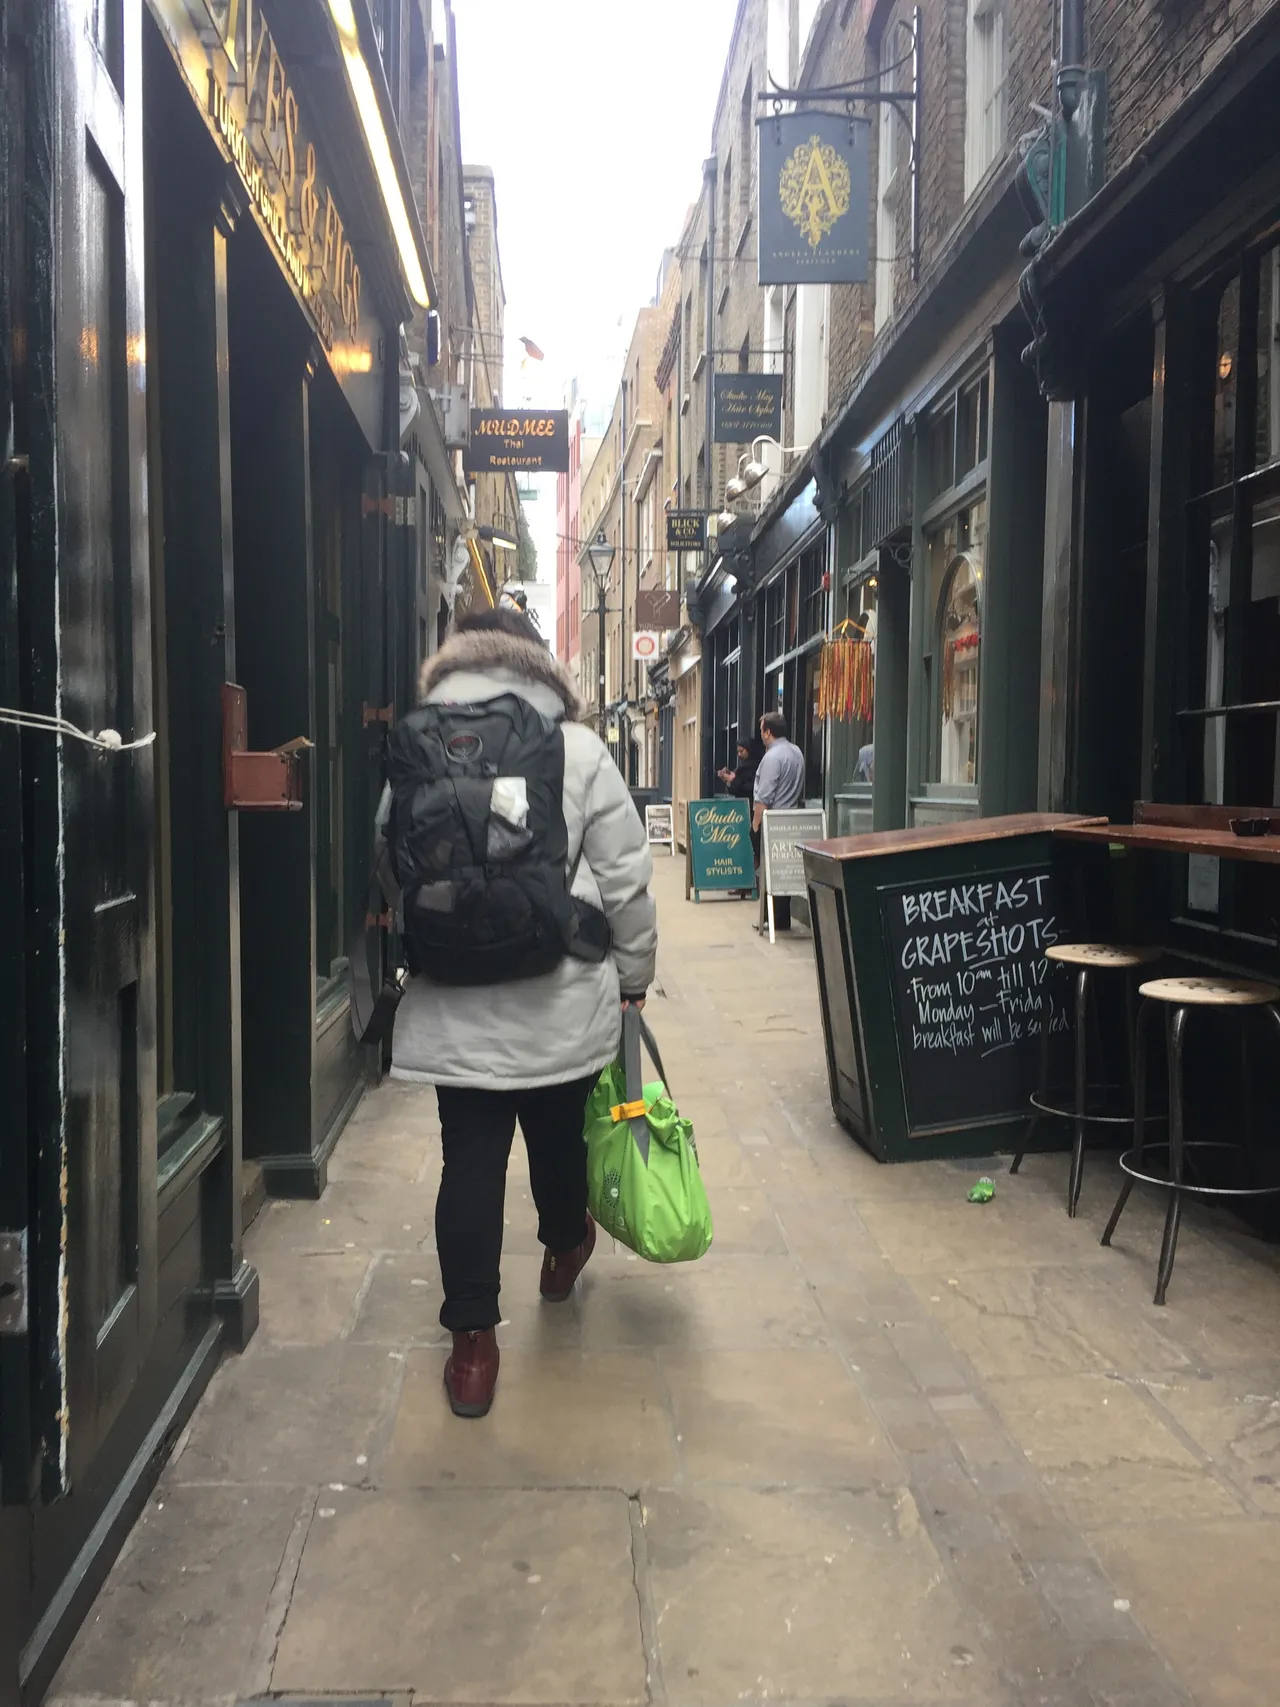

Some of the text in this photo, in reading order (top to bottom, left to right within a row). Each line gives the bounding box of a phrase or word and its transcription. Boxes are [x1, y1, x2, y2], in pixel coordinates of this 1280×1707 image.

[211, 72, 259, 203] TURKISH
[300, 143, 319, 254] &
[321, 186, 361, 345] FIGS
[504, 439, 524, 449] Thai
[490, 455, 542, 466] Restaurant
[671, 519, 700, 528] BLICK
[695, 805, 744, 828] Studio
[701, 824, 740, 850] Mag
[771, 841, 798, 853] ARTI
[771, 852, 804, 860] PERFUM
[706, 866, 743, 876] STYLISTS
[714, 858, 733, 866] HAIR
[902, 875, 1050, 926] BREAKFAST
[976, 911, 999, 927] at
[997, 963, 1024, 990] till
[918, 998, 975, 1025] Monday
[913, 1024, 975, 1057] breakfast
[981, 1016, 1001, 1043] will
[1008, 1014, 1023, 1042] be
